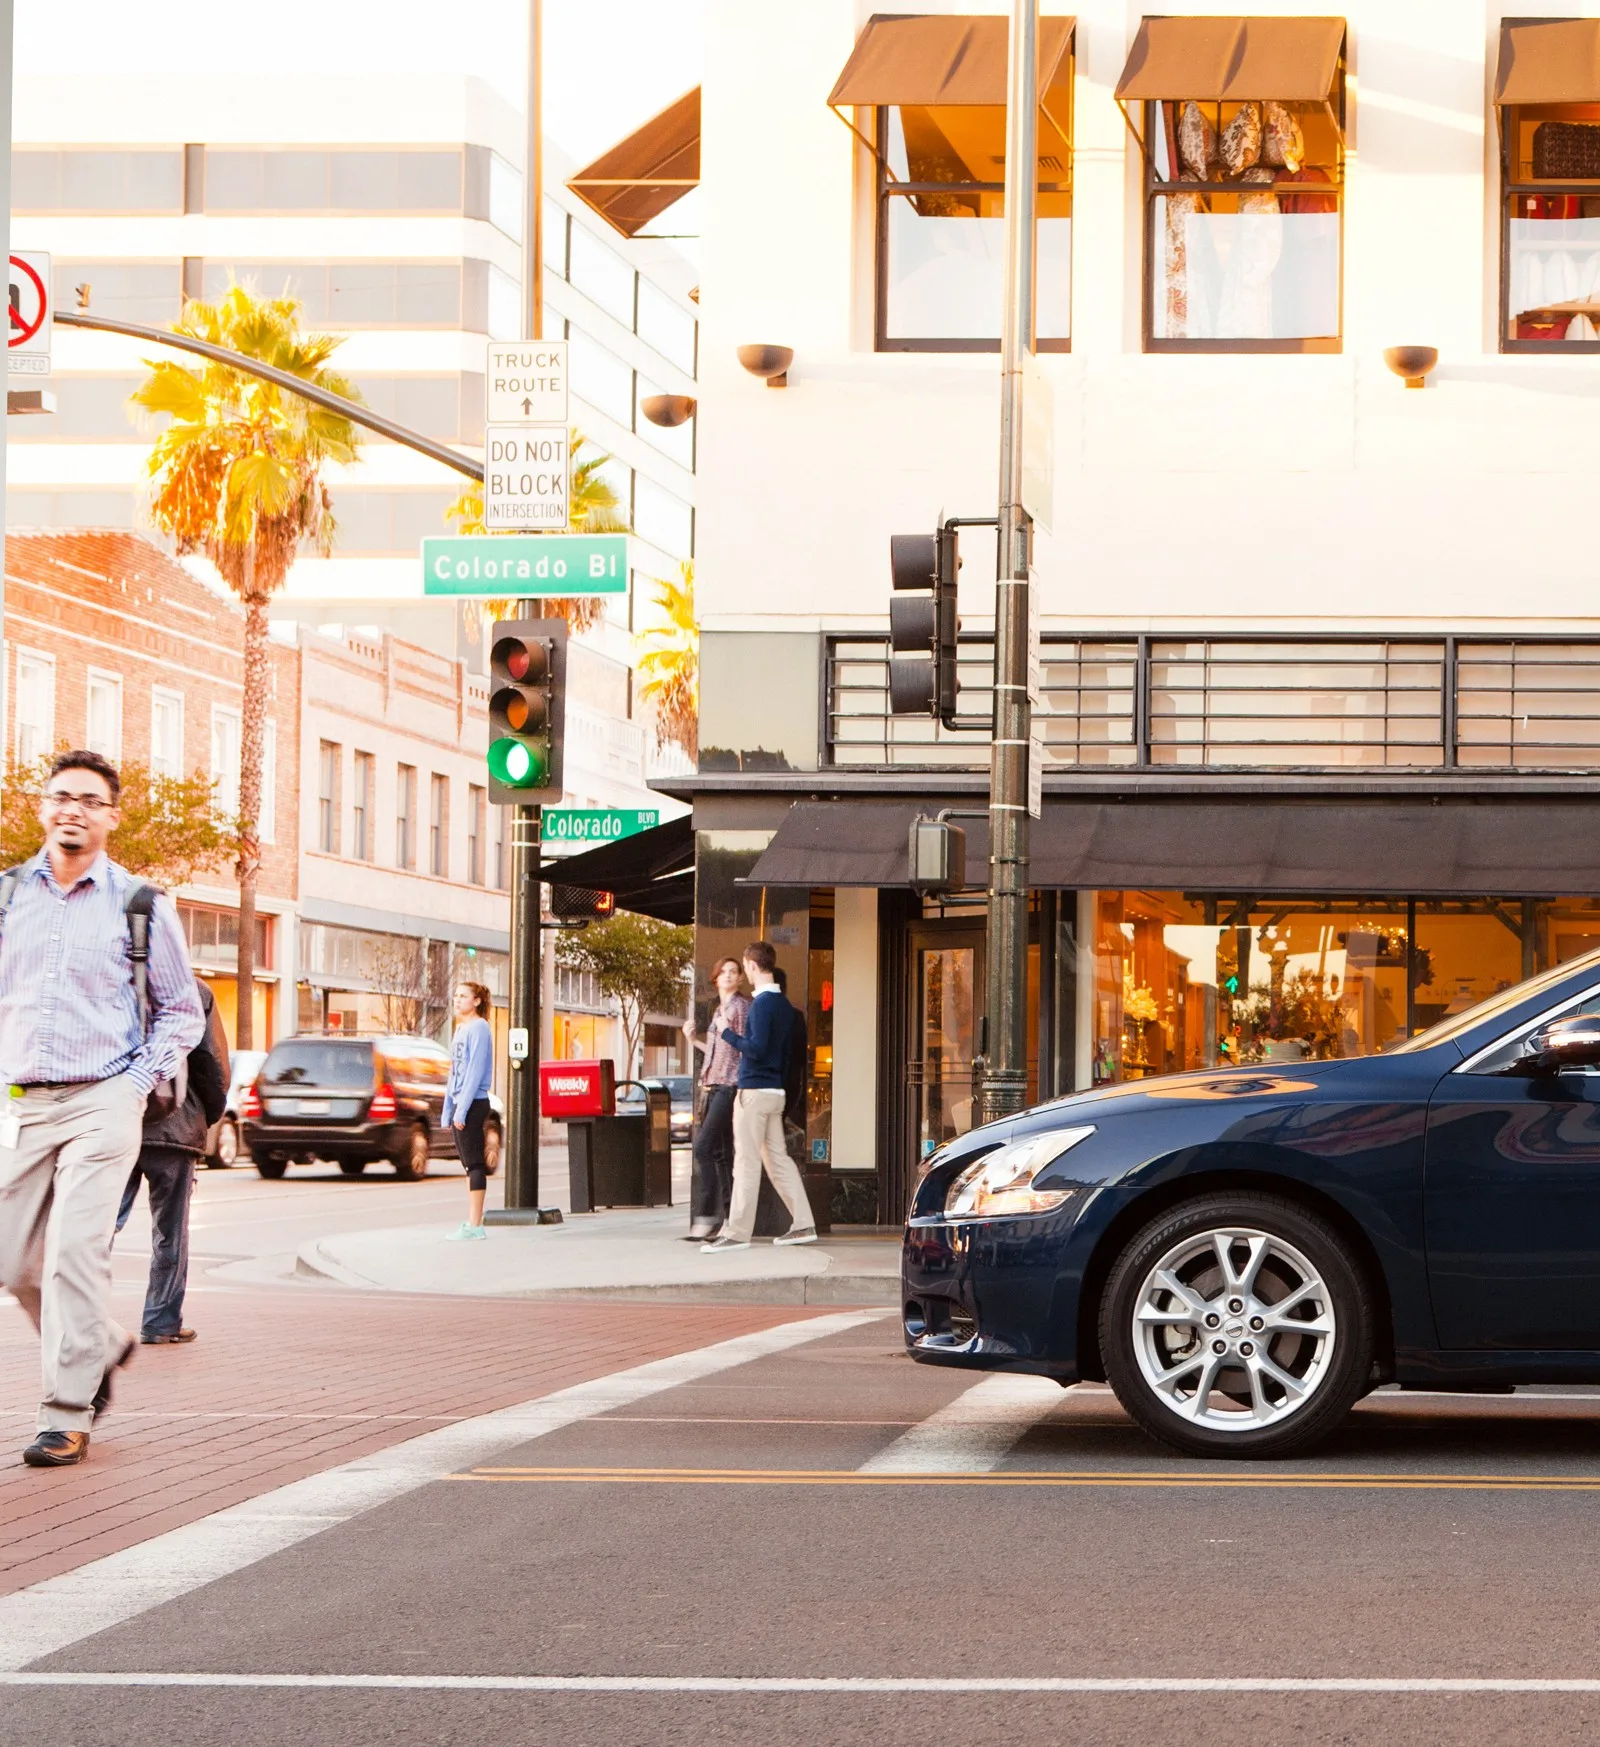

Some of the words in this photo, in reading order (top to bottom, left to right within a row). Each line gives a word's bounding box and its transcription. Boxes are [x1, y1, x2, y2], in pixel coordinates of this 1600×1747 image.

[494, 353, 561, 368] TRUCK
[495, 378, 561, 392] ROUTE
[491, 441, 518, 462] DO
[525, 441, 564, 462] NOT
[491, 474, 563, 495] BLOCK
[489, 503, 564, 518] INTERSECTION
[434, 555, 567, 579] Colorado
[589, 553, 616, 577] Bl
[546, 813, 622, 836] Colorado
[638, 812, 656, 824] BLVD
[549, 1077, 588, 1092] Weekly
